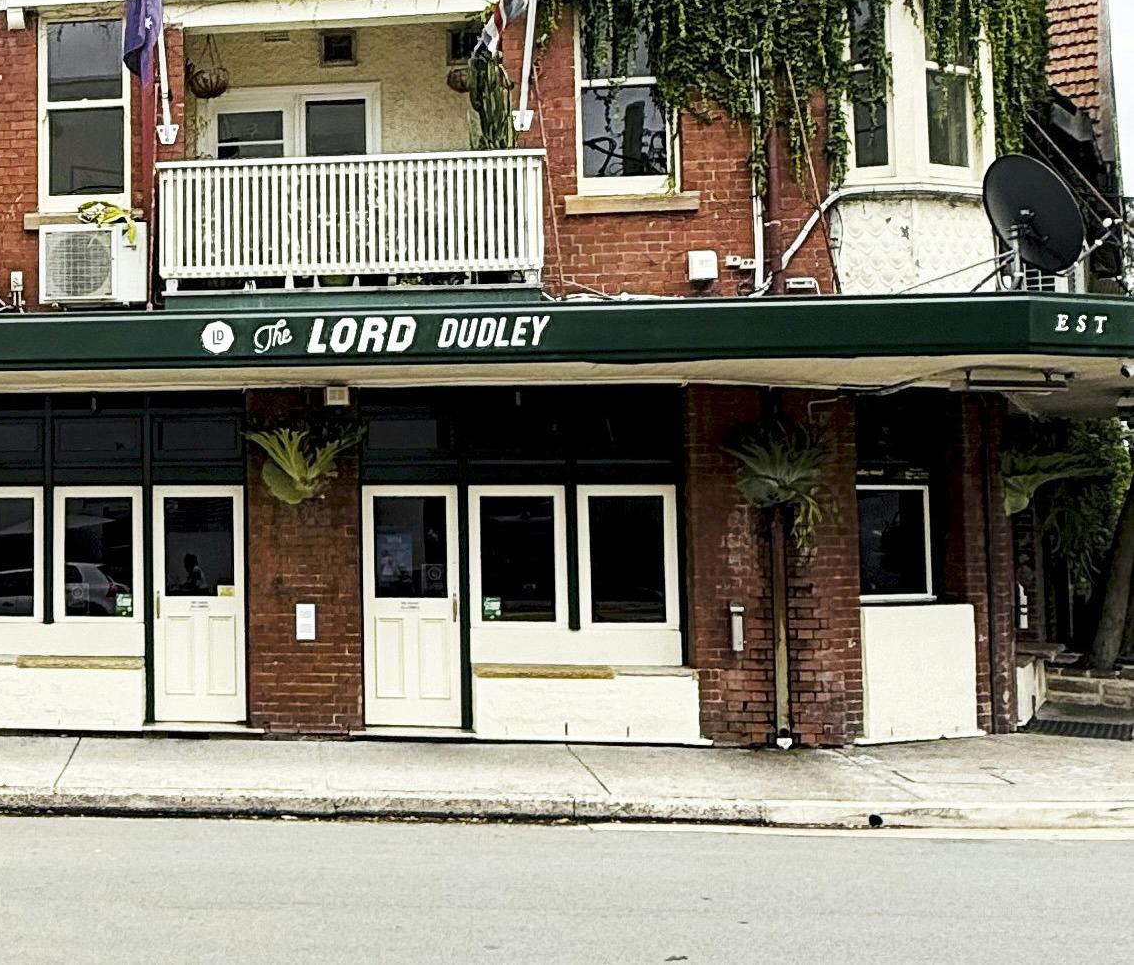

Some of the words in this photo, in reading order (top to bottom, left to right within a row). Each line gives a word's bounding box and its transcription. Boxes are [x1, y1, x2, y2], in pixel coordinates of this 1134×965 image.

[254, 318, 293, 354] The
[307, 316, 418, 353] LORD
[437, 316, 551, 348] DUDLEY
